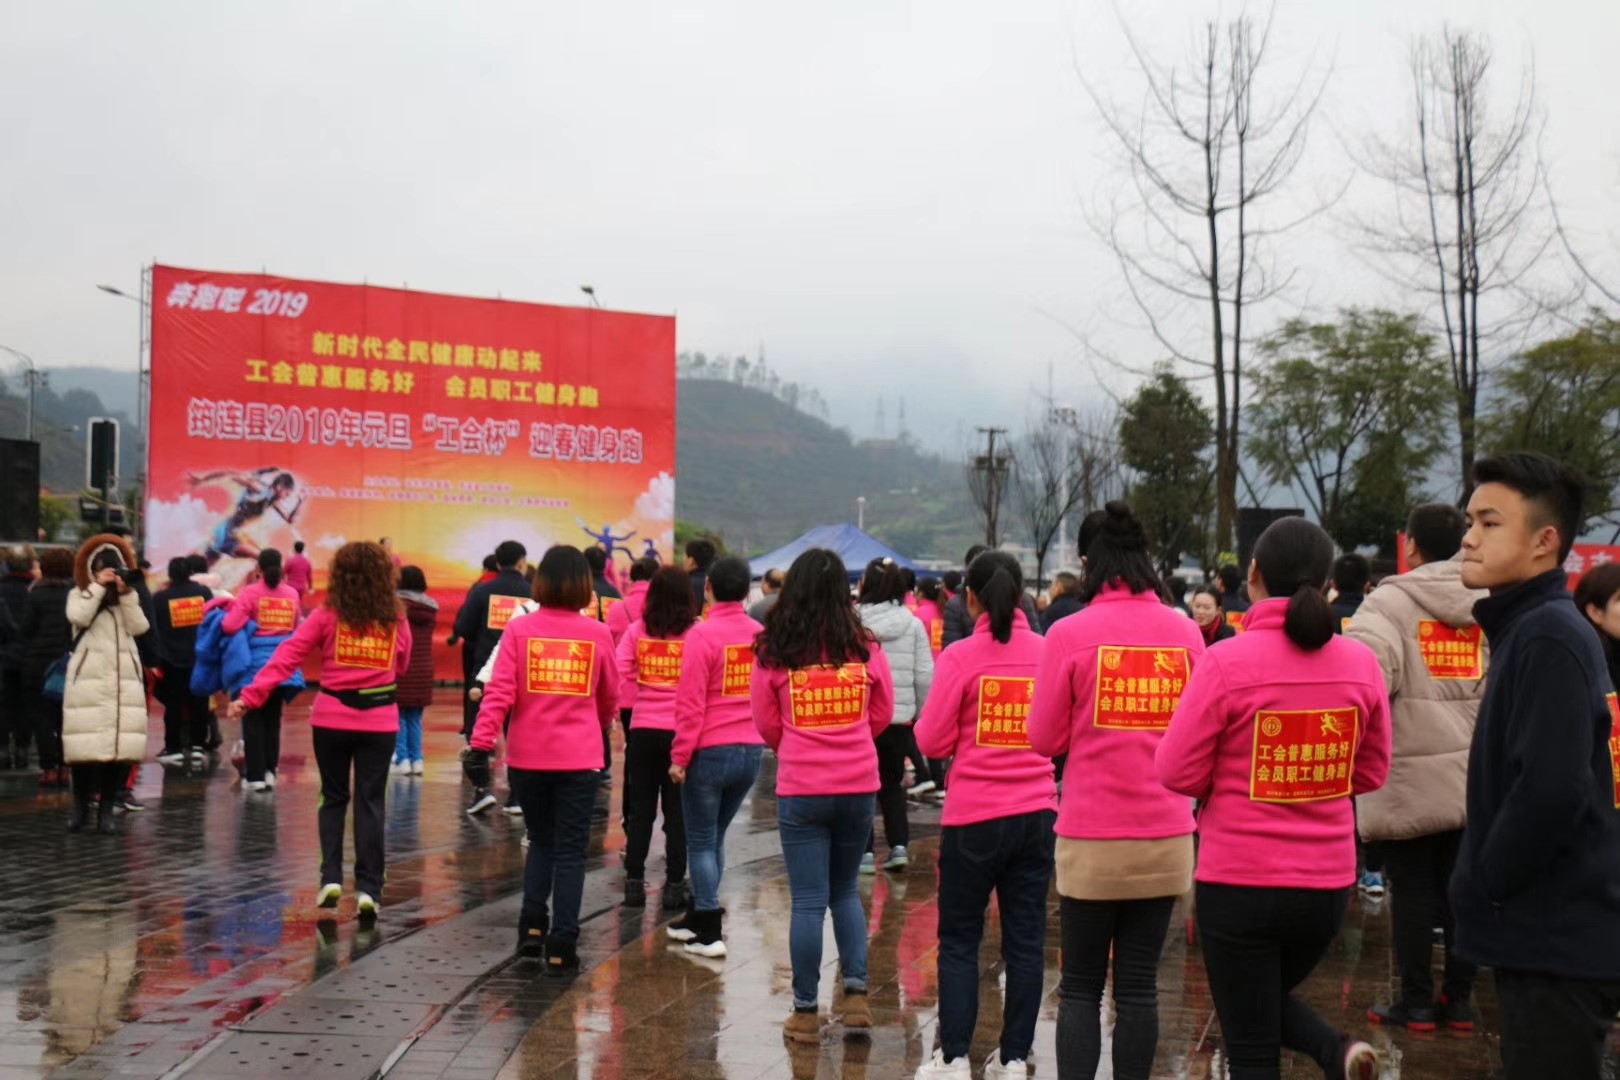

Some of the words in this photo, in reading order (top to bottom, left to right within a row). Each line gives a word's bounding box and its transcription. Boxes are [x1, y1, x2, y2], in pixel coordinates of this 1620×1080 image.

[247, 287, 308, 318] 2019
[245, 359, 414, 394] 工会普惠服务好
[445, 375, 599, 408] 会员职工健身跑
[529, 422, 643, 464] 迎春健身跑
[792, 686, 860, 702] 工会普惠服务好
[1101, 677, 1183, 695] 工会普惠服务好
[795, 700, 860, 717] 会员职工健身跑
[1258, 741, 1349, 762] 工会普惠服务好
[1257, 762, 1347, 784] 会员职工健身跑
